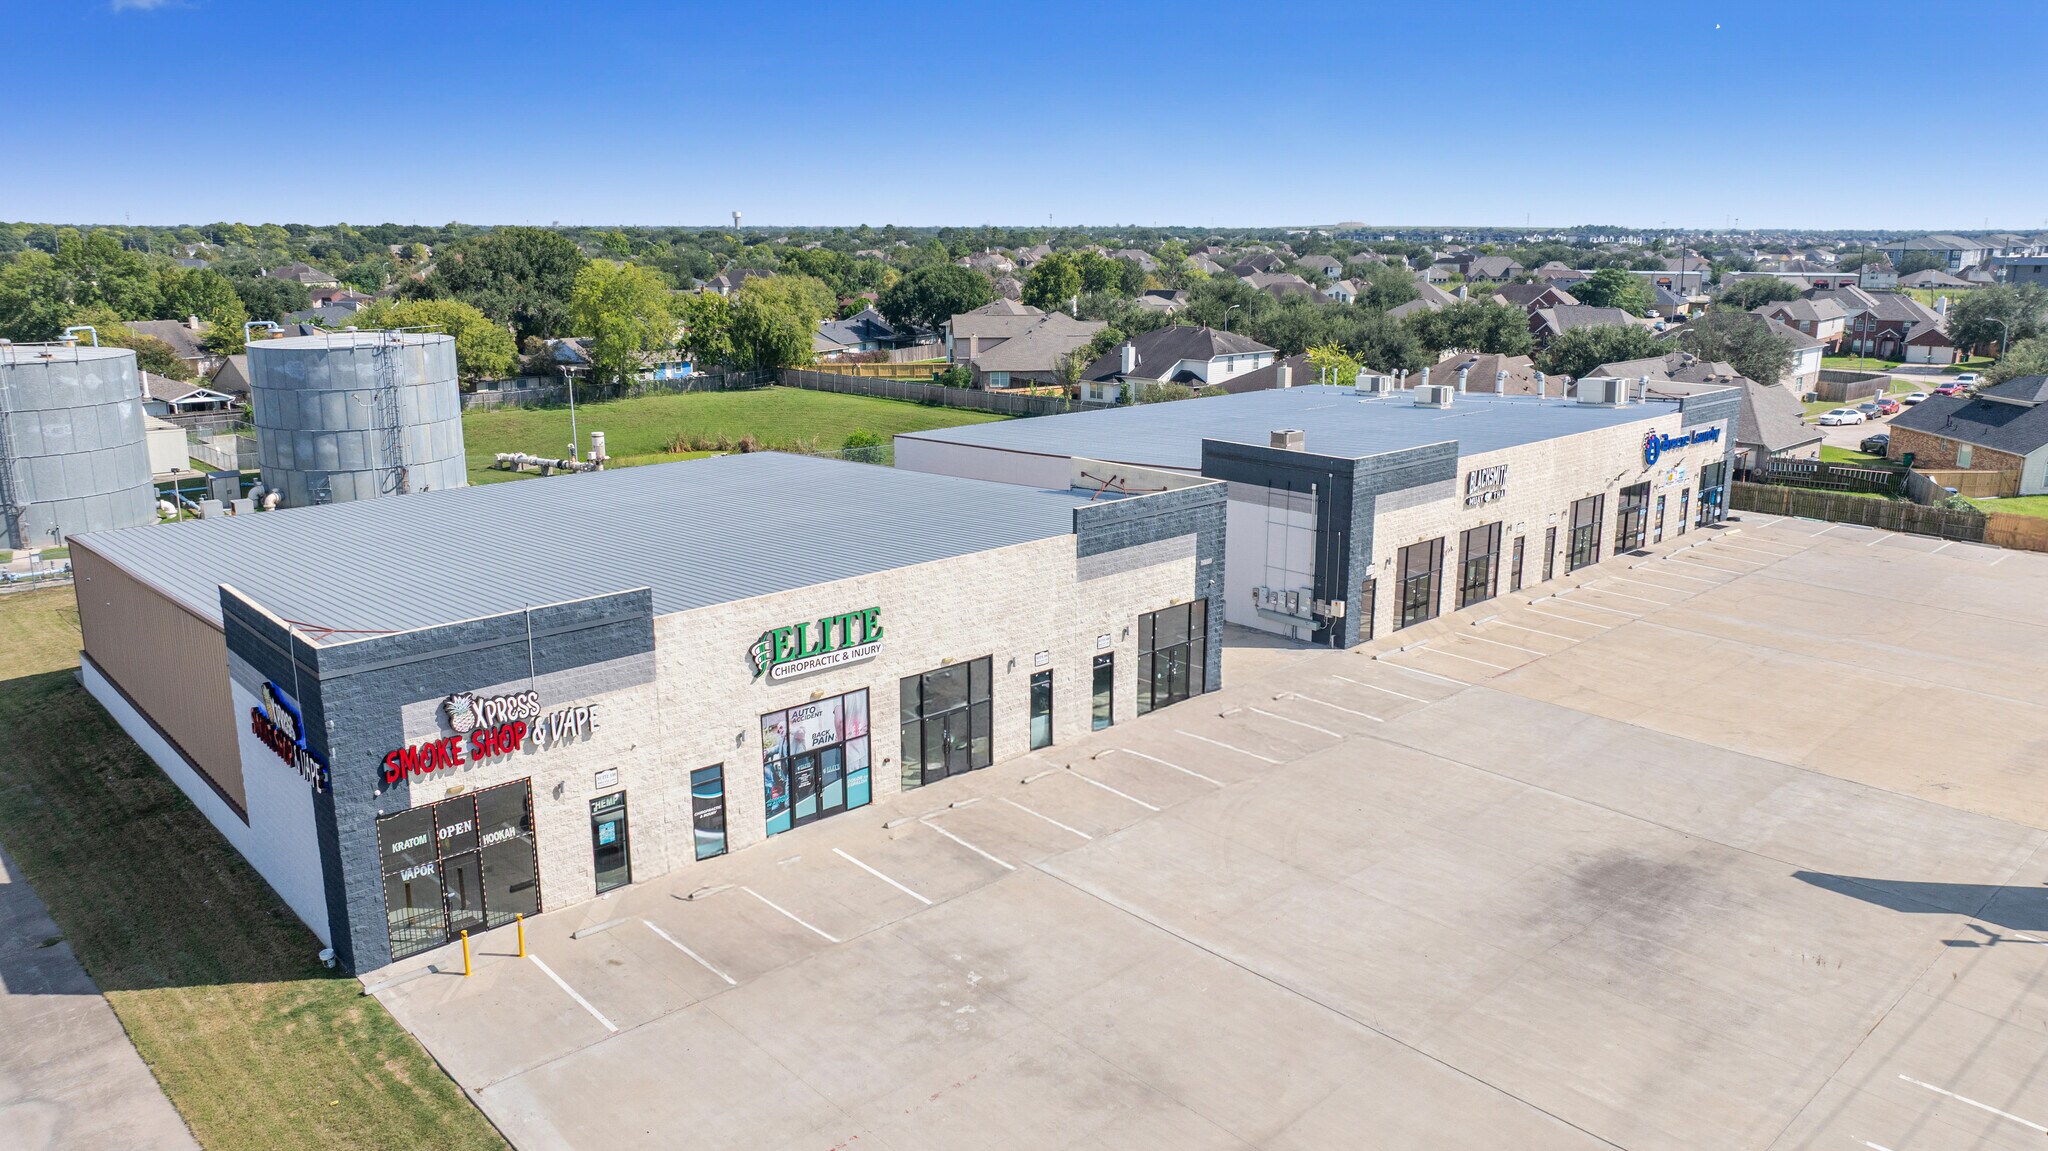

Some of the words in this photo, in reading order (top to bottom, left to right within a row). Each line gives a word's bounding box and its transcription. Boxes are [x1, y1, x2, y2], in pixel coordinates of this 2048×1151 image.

[1691, 426, 1721, 444] Laundry
[1467, 464, 1507, 496] BLACKSMITH
[769, 606, 884, 664] ELITE
[775, 653, 840, 676] CHIROPRACTIC
[842, 651, 850, 660] &
[851, 644, 881, 659] INJURY
[472, 691, 540, 729] XPRESS
[792, 706, 816, 719] AUTO
[792, 711, 823, 724] ACCIDENT
[385, 735, 465, 783] SMOKE
[471, 721, 527, 761] SHOP
[531, 716, 547, 745] &
[549, 704, 600, 741] VAPE
[812, 729, 830, 740] BACK
[812, 733, 835, 747] PAIN
[592, 796, 618, 812] HEMP
[392, 834, 428, 853] KRATOM
[439, 820, 473, 840] OPEN
[482, 826, 516, 845] HOOKAH
[400, 864, 435, 881] VAPOR
